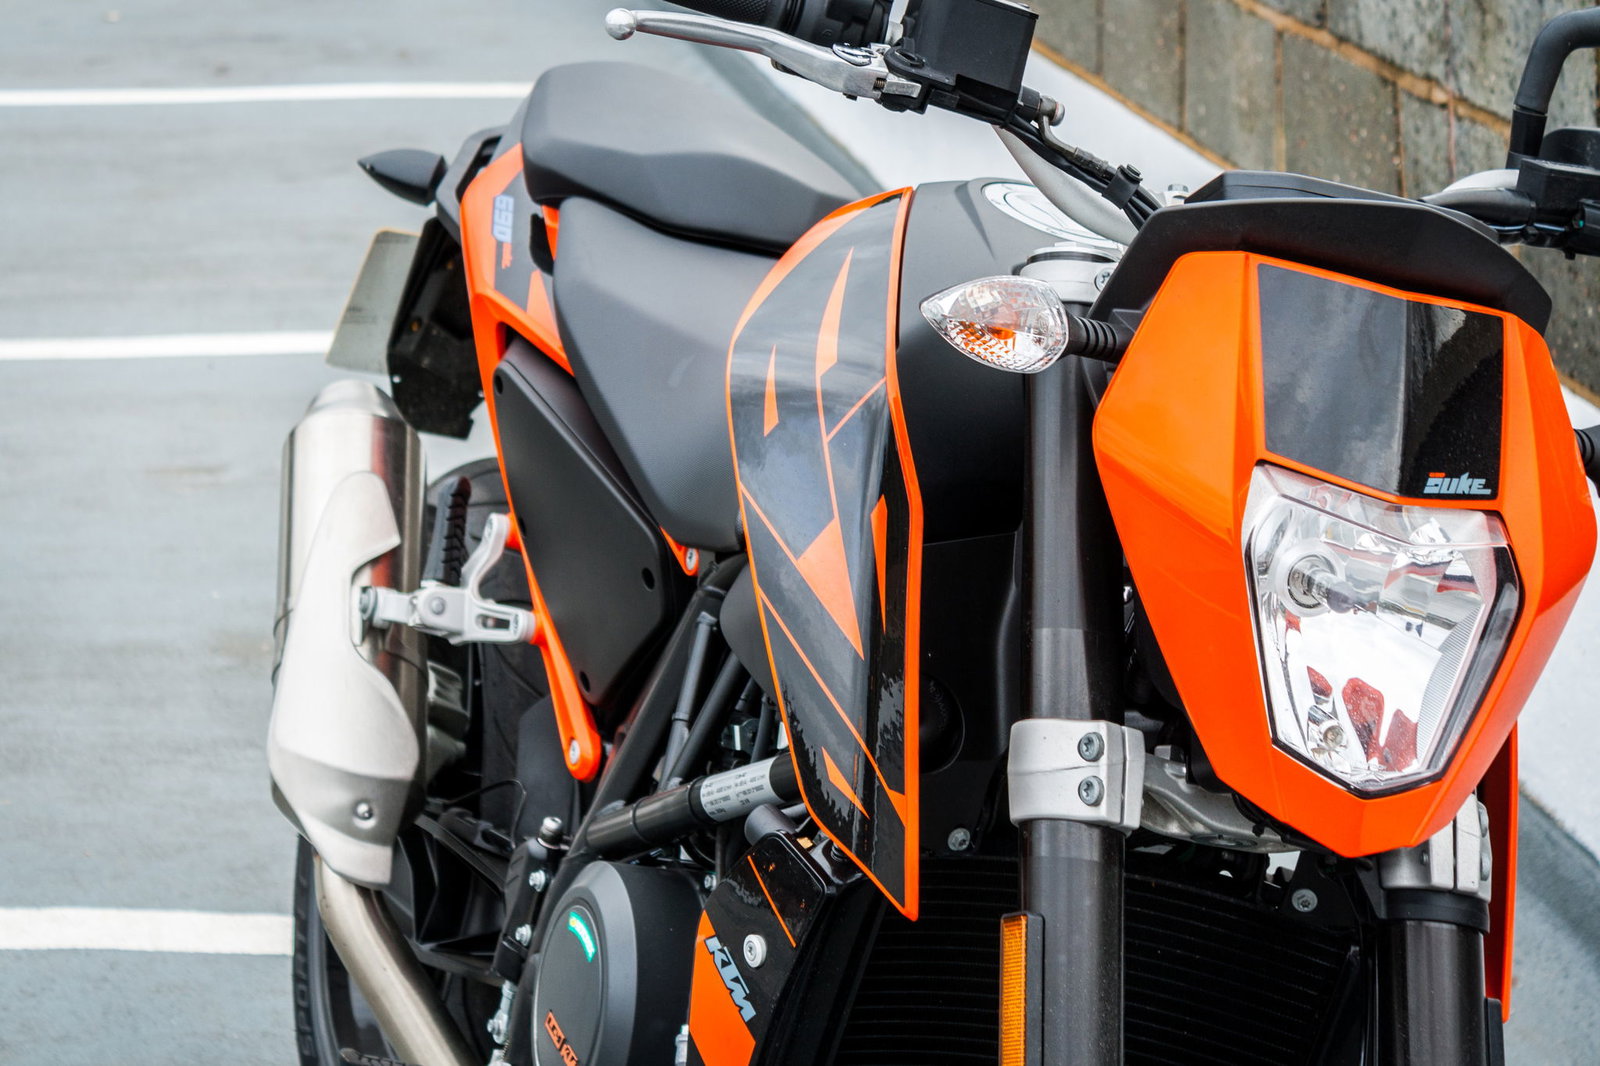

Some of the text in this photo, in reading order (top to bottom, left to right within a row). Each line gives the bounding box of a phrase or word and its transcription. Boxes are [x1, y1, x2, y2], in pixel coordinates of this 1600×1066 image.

[493, 195, 514, 243] 690
[704, 936, 757, 1022] KTM
[560, 1044, 579, 1066] KT
